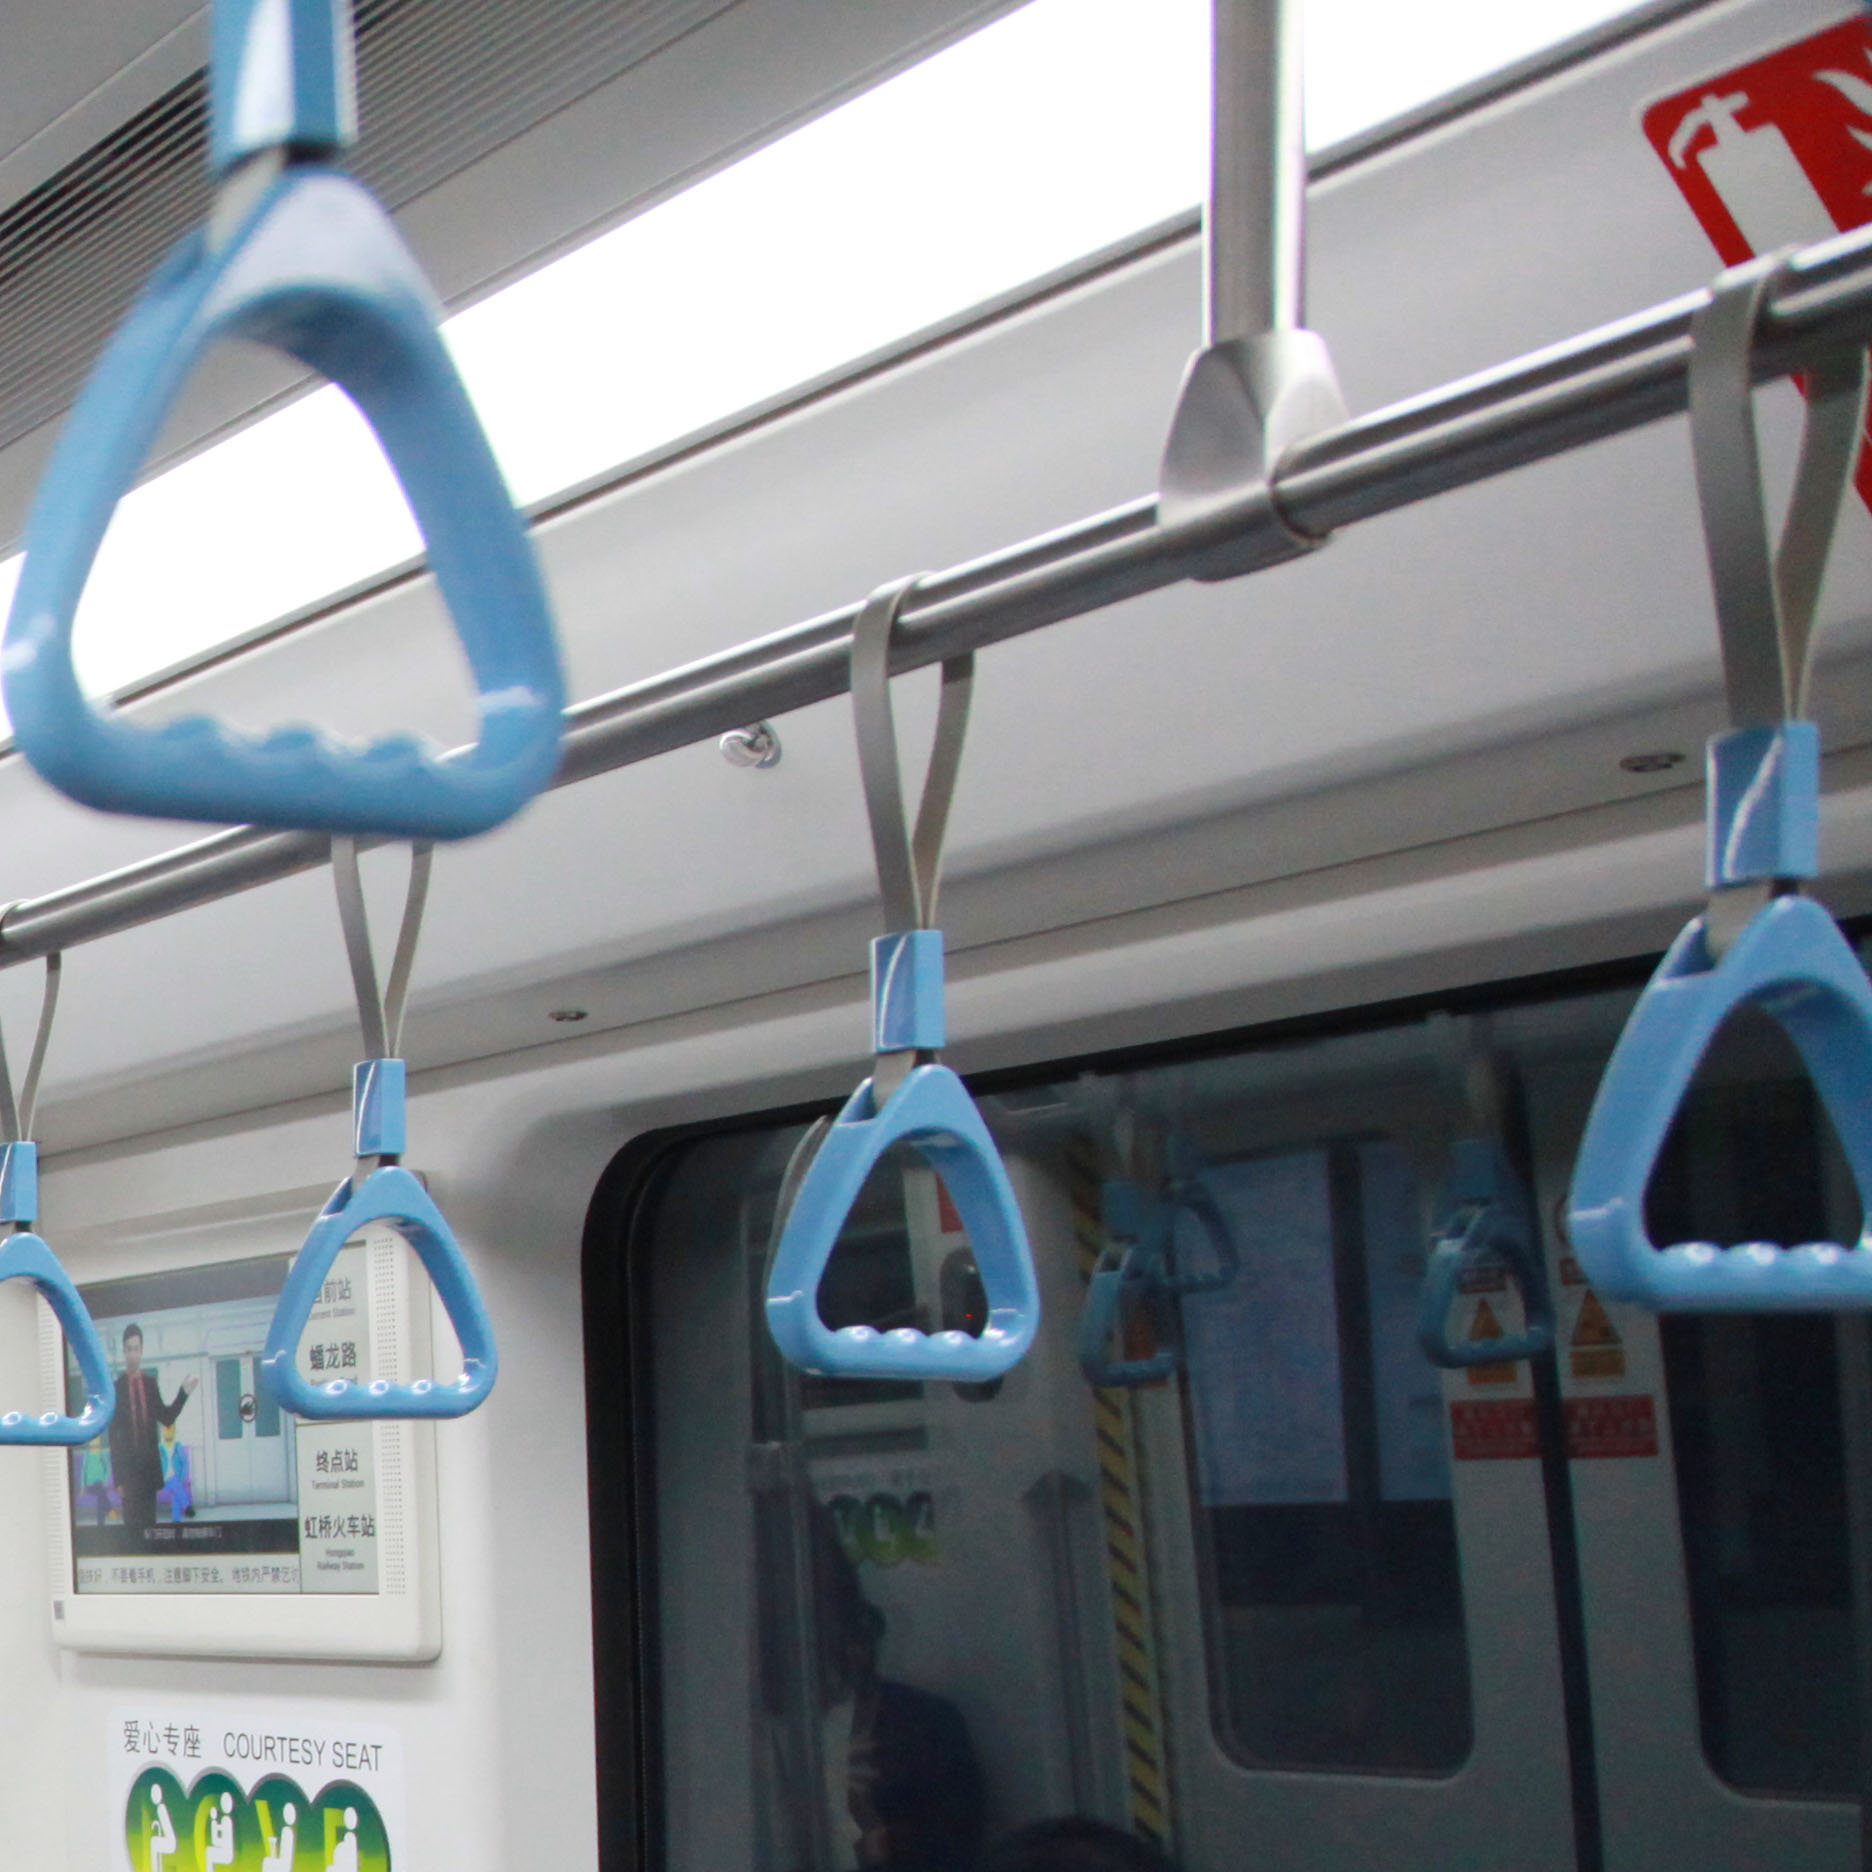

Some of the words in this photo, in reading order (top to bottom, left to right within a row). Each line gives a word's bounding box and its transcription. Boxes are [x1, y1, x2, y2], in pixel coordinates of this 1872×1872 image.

[316, 1448, 358, 1473] 终点站
[304, 1513, 375, 1539] 虹桥火车站
[123, 1720, 202, 1759] 爱心专座
[223, 1732, 326, 1765] COURTESY
[332, 1741, 382, 1772] SEAT
